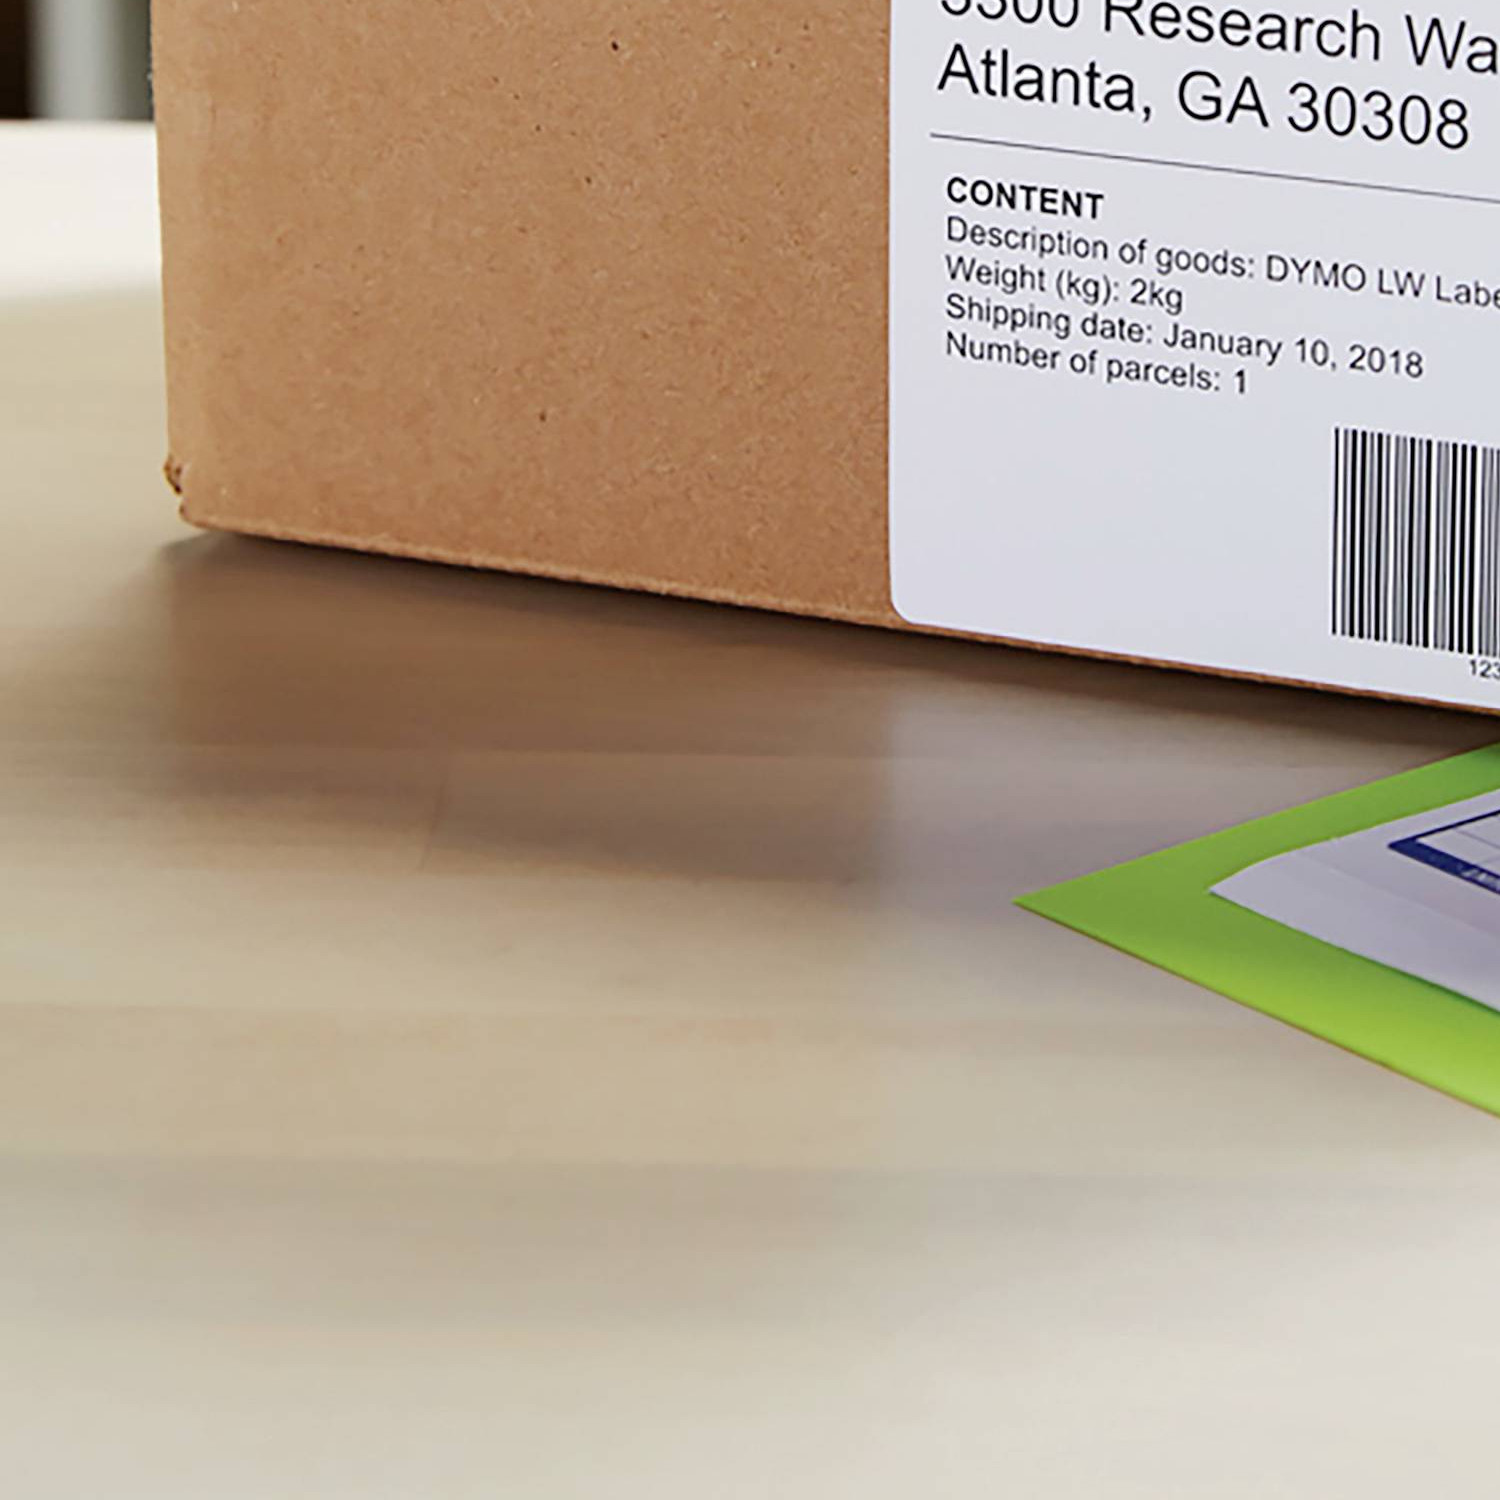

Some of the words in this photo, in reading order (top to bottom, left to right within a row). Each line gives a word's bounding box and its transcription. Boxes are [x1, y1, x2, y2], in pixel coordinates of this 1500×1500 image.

[936, 42, 1152, 123] Atlanta,
[1177, 69, 1270, 129] GA
[1287, 81, 1469, 151] 30308
[946, 176, 1105, 220] CONTENT
[944, 254, 1046, 295] Weight
[1055, 269, 1119, 307] (kg):
[1130, 277, 1183, 317] 2kg
[947, 215, 1109, 261] Description
[1118, 238, 1148, 265] of
[1155, 247, 1255, 279] goods:
[1266, 254, 1367, 292] DYMO
[1377, 268, 1426, 298] LW
[945, 292, 1071, 341] Shipping
[1080, 311, 1153, 344] date:
[1163, 322, 1283, 367] January
[1295, 337, 1337, 371] 10,
[1348, 343, 1424, 379] 2018
[946, 330, 1061, 370] Number
[1069, 349, 1099, 375] of
[1106, 358, 1220, 392] parcels:
[1233, 367, 1247, 396] 1
